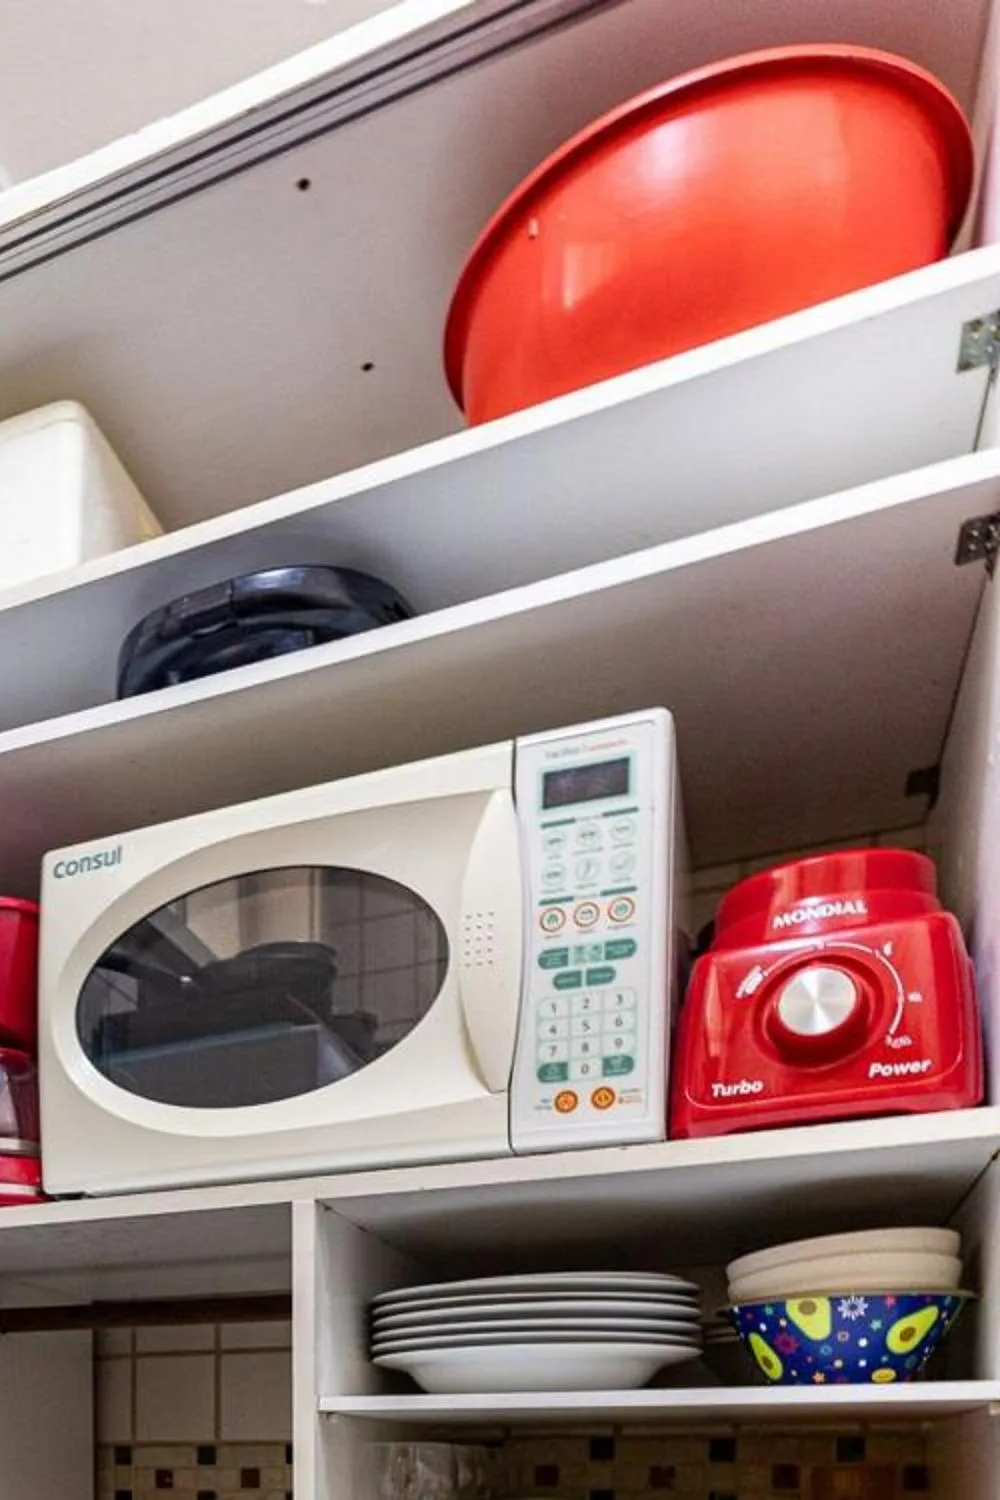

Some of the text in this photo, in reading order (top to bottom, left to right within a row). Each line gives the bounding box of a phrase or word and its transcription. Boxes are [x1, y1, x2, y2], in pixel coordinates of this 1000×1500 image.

[773, 899, 868, 929] MONDIAL
[868, 1058, 932, 1078] Power
[711, 1078, 764, 1098] Turbo
